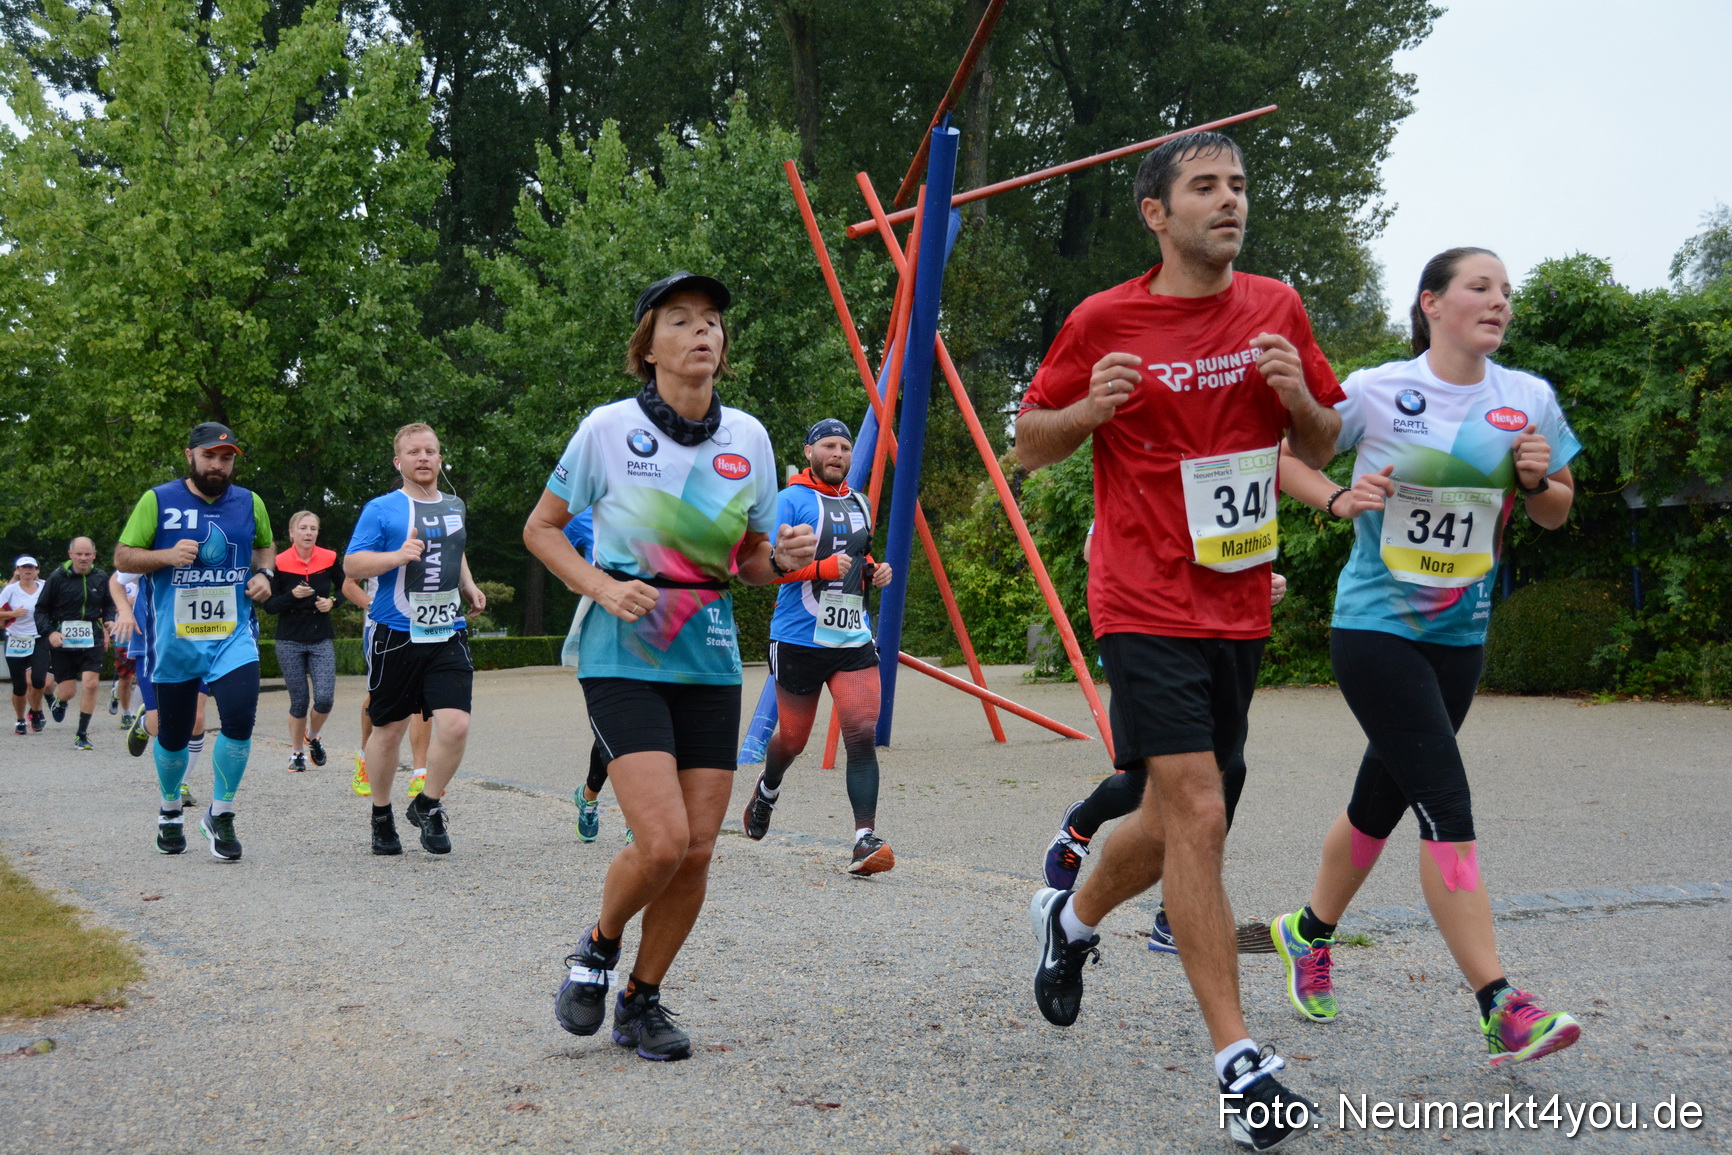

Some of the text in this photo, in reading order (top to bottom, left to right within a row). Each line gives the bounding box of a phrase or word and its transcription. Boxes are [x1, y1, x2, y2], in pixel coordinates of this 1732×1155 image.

[1196, 347, 1264, 374] RUNNER
[1198, 367, 1246, 390] POINT
[1393, 418, 1429, 430] PARTL
[1491, 412, 1524, 425] Hervis
[1393, 426, 1429, 436] Neumarkt
[627, 460, 662, 472] PARTL
[717, 458, 747, 474] Hervis
[627, 469, 662, 479] Neumarkt
[1193, 469, 1233, 480] NeuerMarkt
[1396, 492, 1434, 504] NeuerMarkt
[1441, 491, 1493, 505] BOCK
[163, 508, 198, 530] 21
[1407, 508, 1474, 548] 341
[1222, 533, 1272, 558] Matthias
[1420, 555, 1455, 574] Nora
[173, 569, 246, 583] FIBALON
[188, 600, 225, 620] 194
[416, 602, 458, 625] 2253
[707, 607, 723, 625] 17.
[823, 606, 862, 629] 3039
[65, 627, 90, 638] 2358
[185, 624, 227, 634] Constantin
[10, 639, 32, 649] 2751
